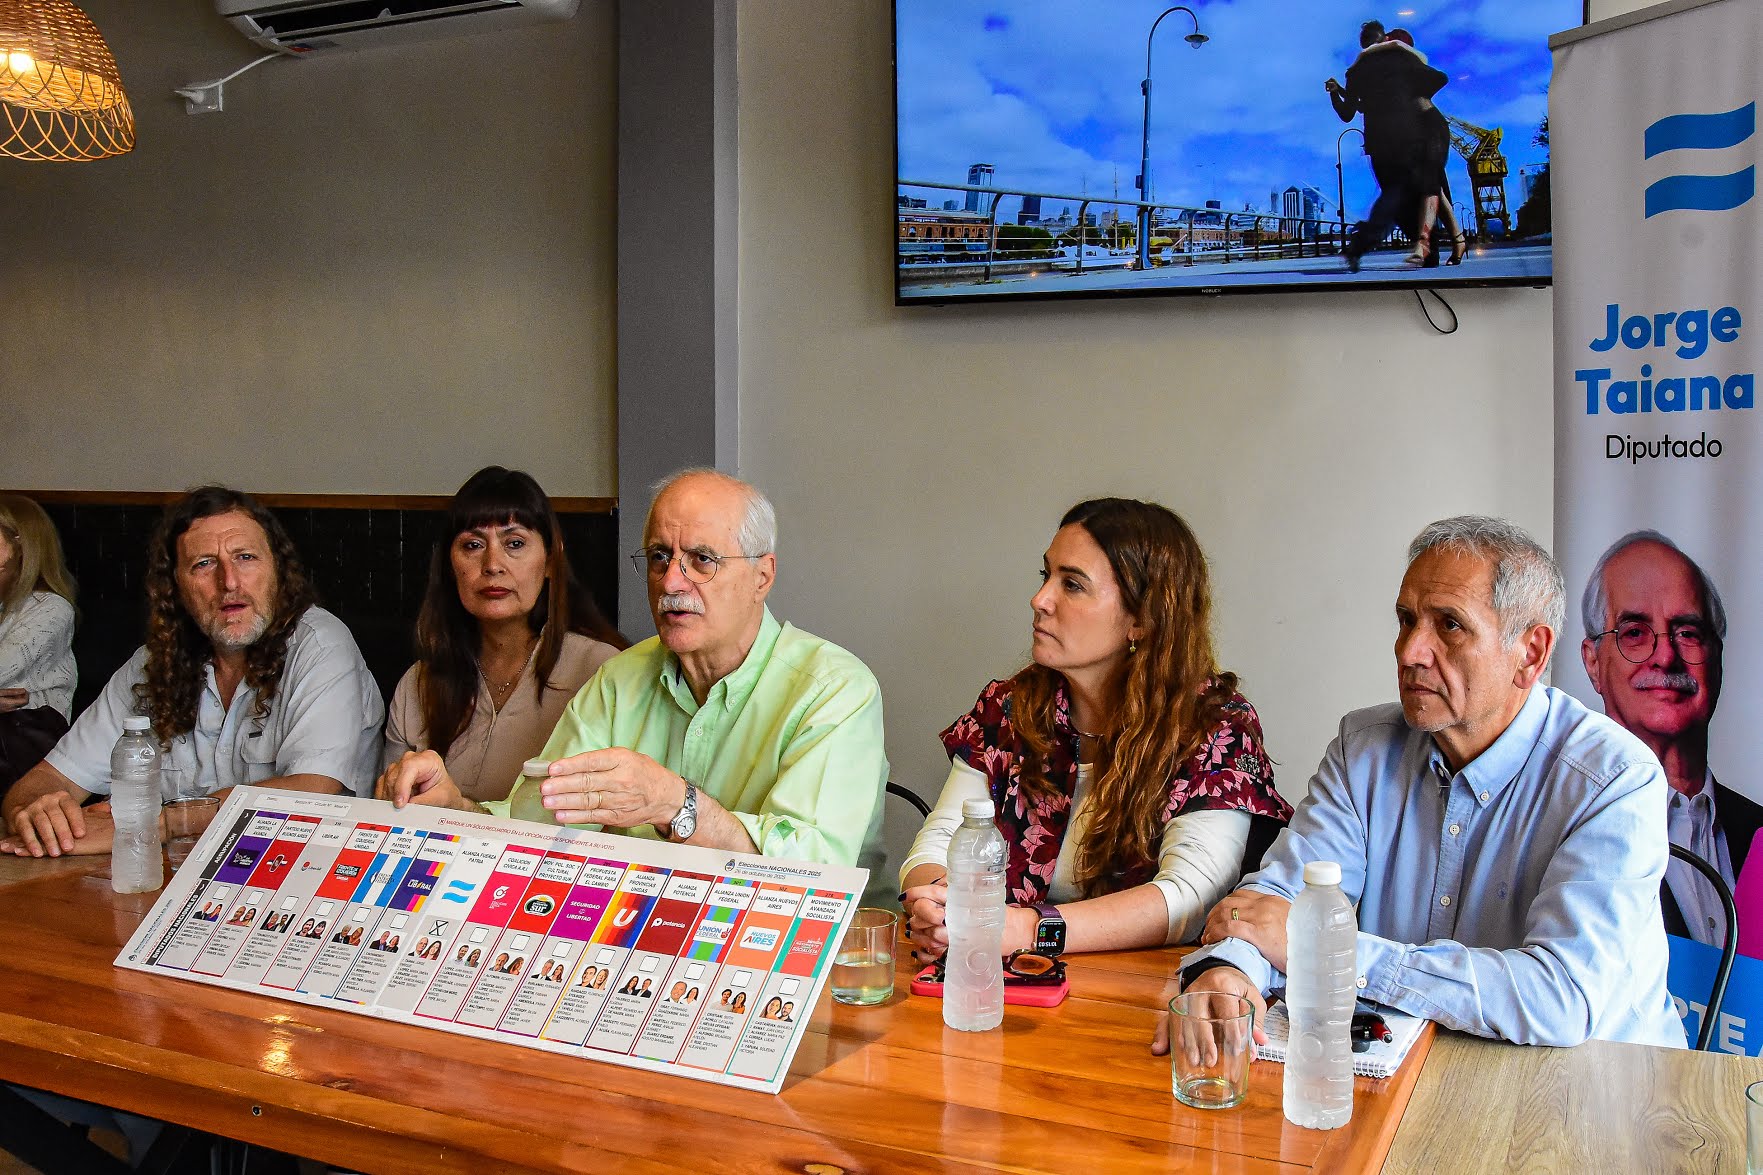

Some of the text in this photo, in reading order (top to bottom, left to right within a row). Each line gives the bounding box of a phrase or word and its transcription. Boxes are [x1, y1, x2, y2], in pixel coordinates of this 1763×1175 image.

[1589, 304, 1742, 359] Jorge
[1575, 364, 1754, 414] Taiana
[1606, 432, 1722, 464] Diputado
[546, 867, 570, 875] CULTURAL
[589, 867, 616, 875] PROPUESTA
[738, 861, 768, 869] Elecciones
[768, 865, 807, 875] NACIONALES
[537, 872, 563, 880] PROYECTO
[628, 880, 657, 888] PROVINCIAS
[672, 889, 697, 897] POTENCIA
[570, 901, 601, 910] SEGURIDAD
[810, 899, 842, 908] MOVIMIENTO
[566, 914, 592, 922] LIBERTAD
[613, 908, 638, 927] U
[805, 912, 835, 920] SOCIALISTA
[152, 928, 176, 958] DIPUTADOS
[174, 895, 199, 928] NACIONALES
[752, 931, 776, 939] NUEVOS
